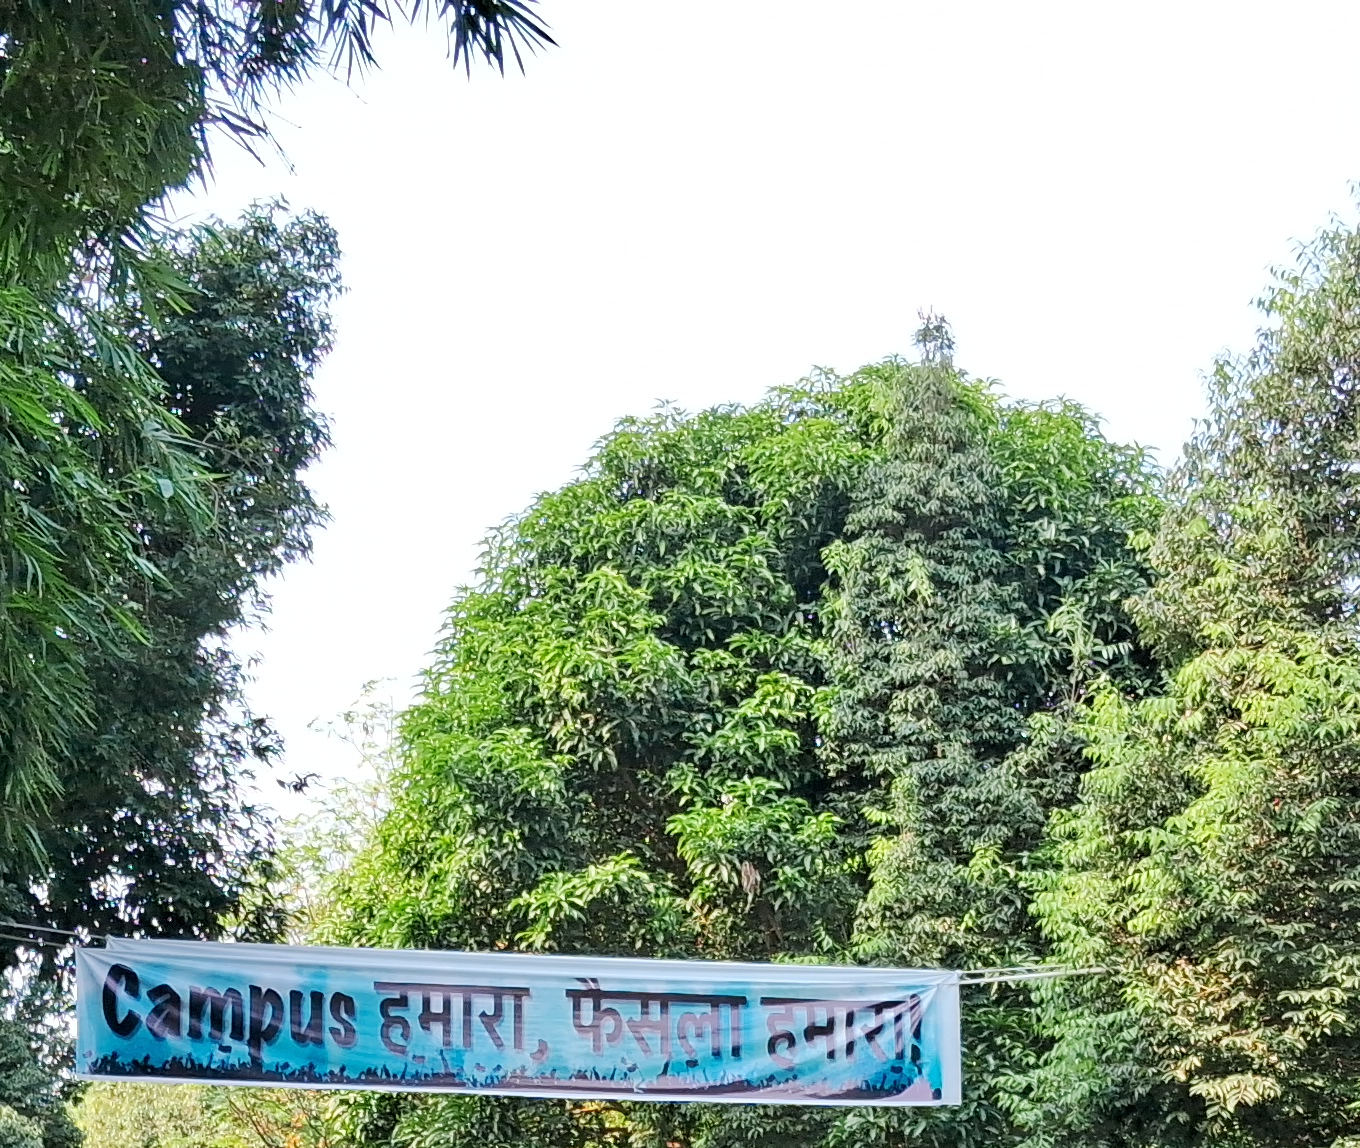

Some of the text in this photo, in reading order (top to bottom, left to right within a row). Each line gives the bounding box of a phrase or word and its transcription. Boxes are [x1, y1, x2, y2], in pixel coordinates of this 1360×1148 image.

[102, 963, 357, 1061] Campus
[373, 981, 549, 1063] हमारा,
[565, 977, 747, 1059] फैसला
